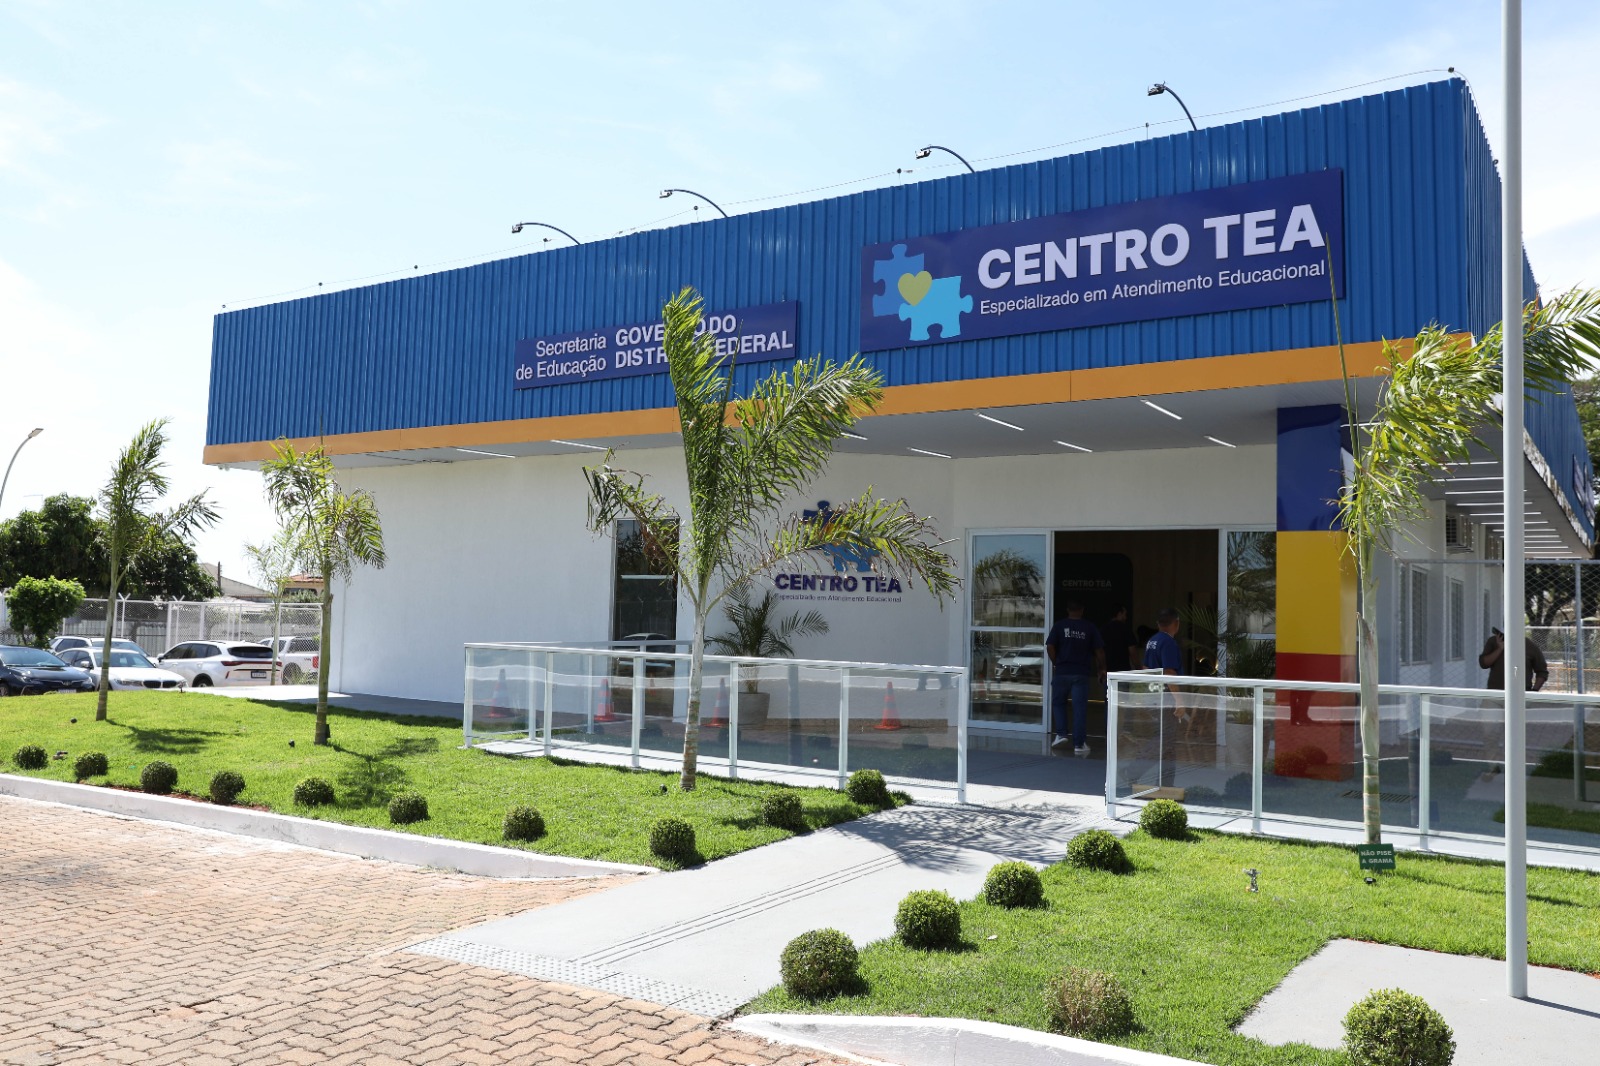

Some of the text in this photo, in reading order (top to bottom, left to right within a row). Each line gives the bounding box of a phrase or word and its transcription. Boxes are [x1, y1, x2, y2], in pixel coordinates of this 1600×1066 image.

[978, 204, 1326, 289] CENTRO TEA
[980, 260, 1326, 315] Especializado em Atendimento Educacional
[535, 333, 607, 358] Secretaria
[616, 318, 707, 347] GOVEO
[515, 357, 607, 381] de Educação
[775, 573, 902, 593] CENTRO TEA
